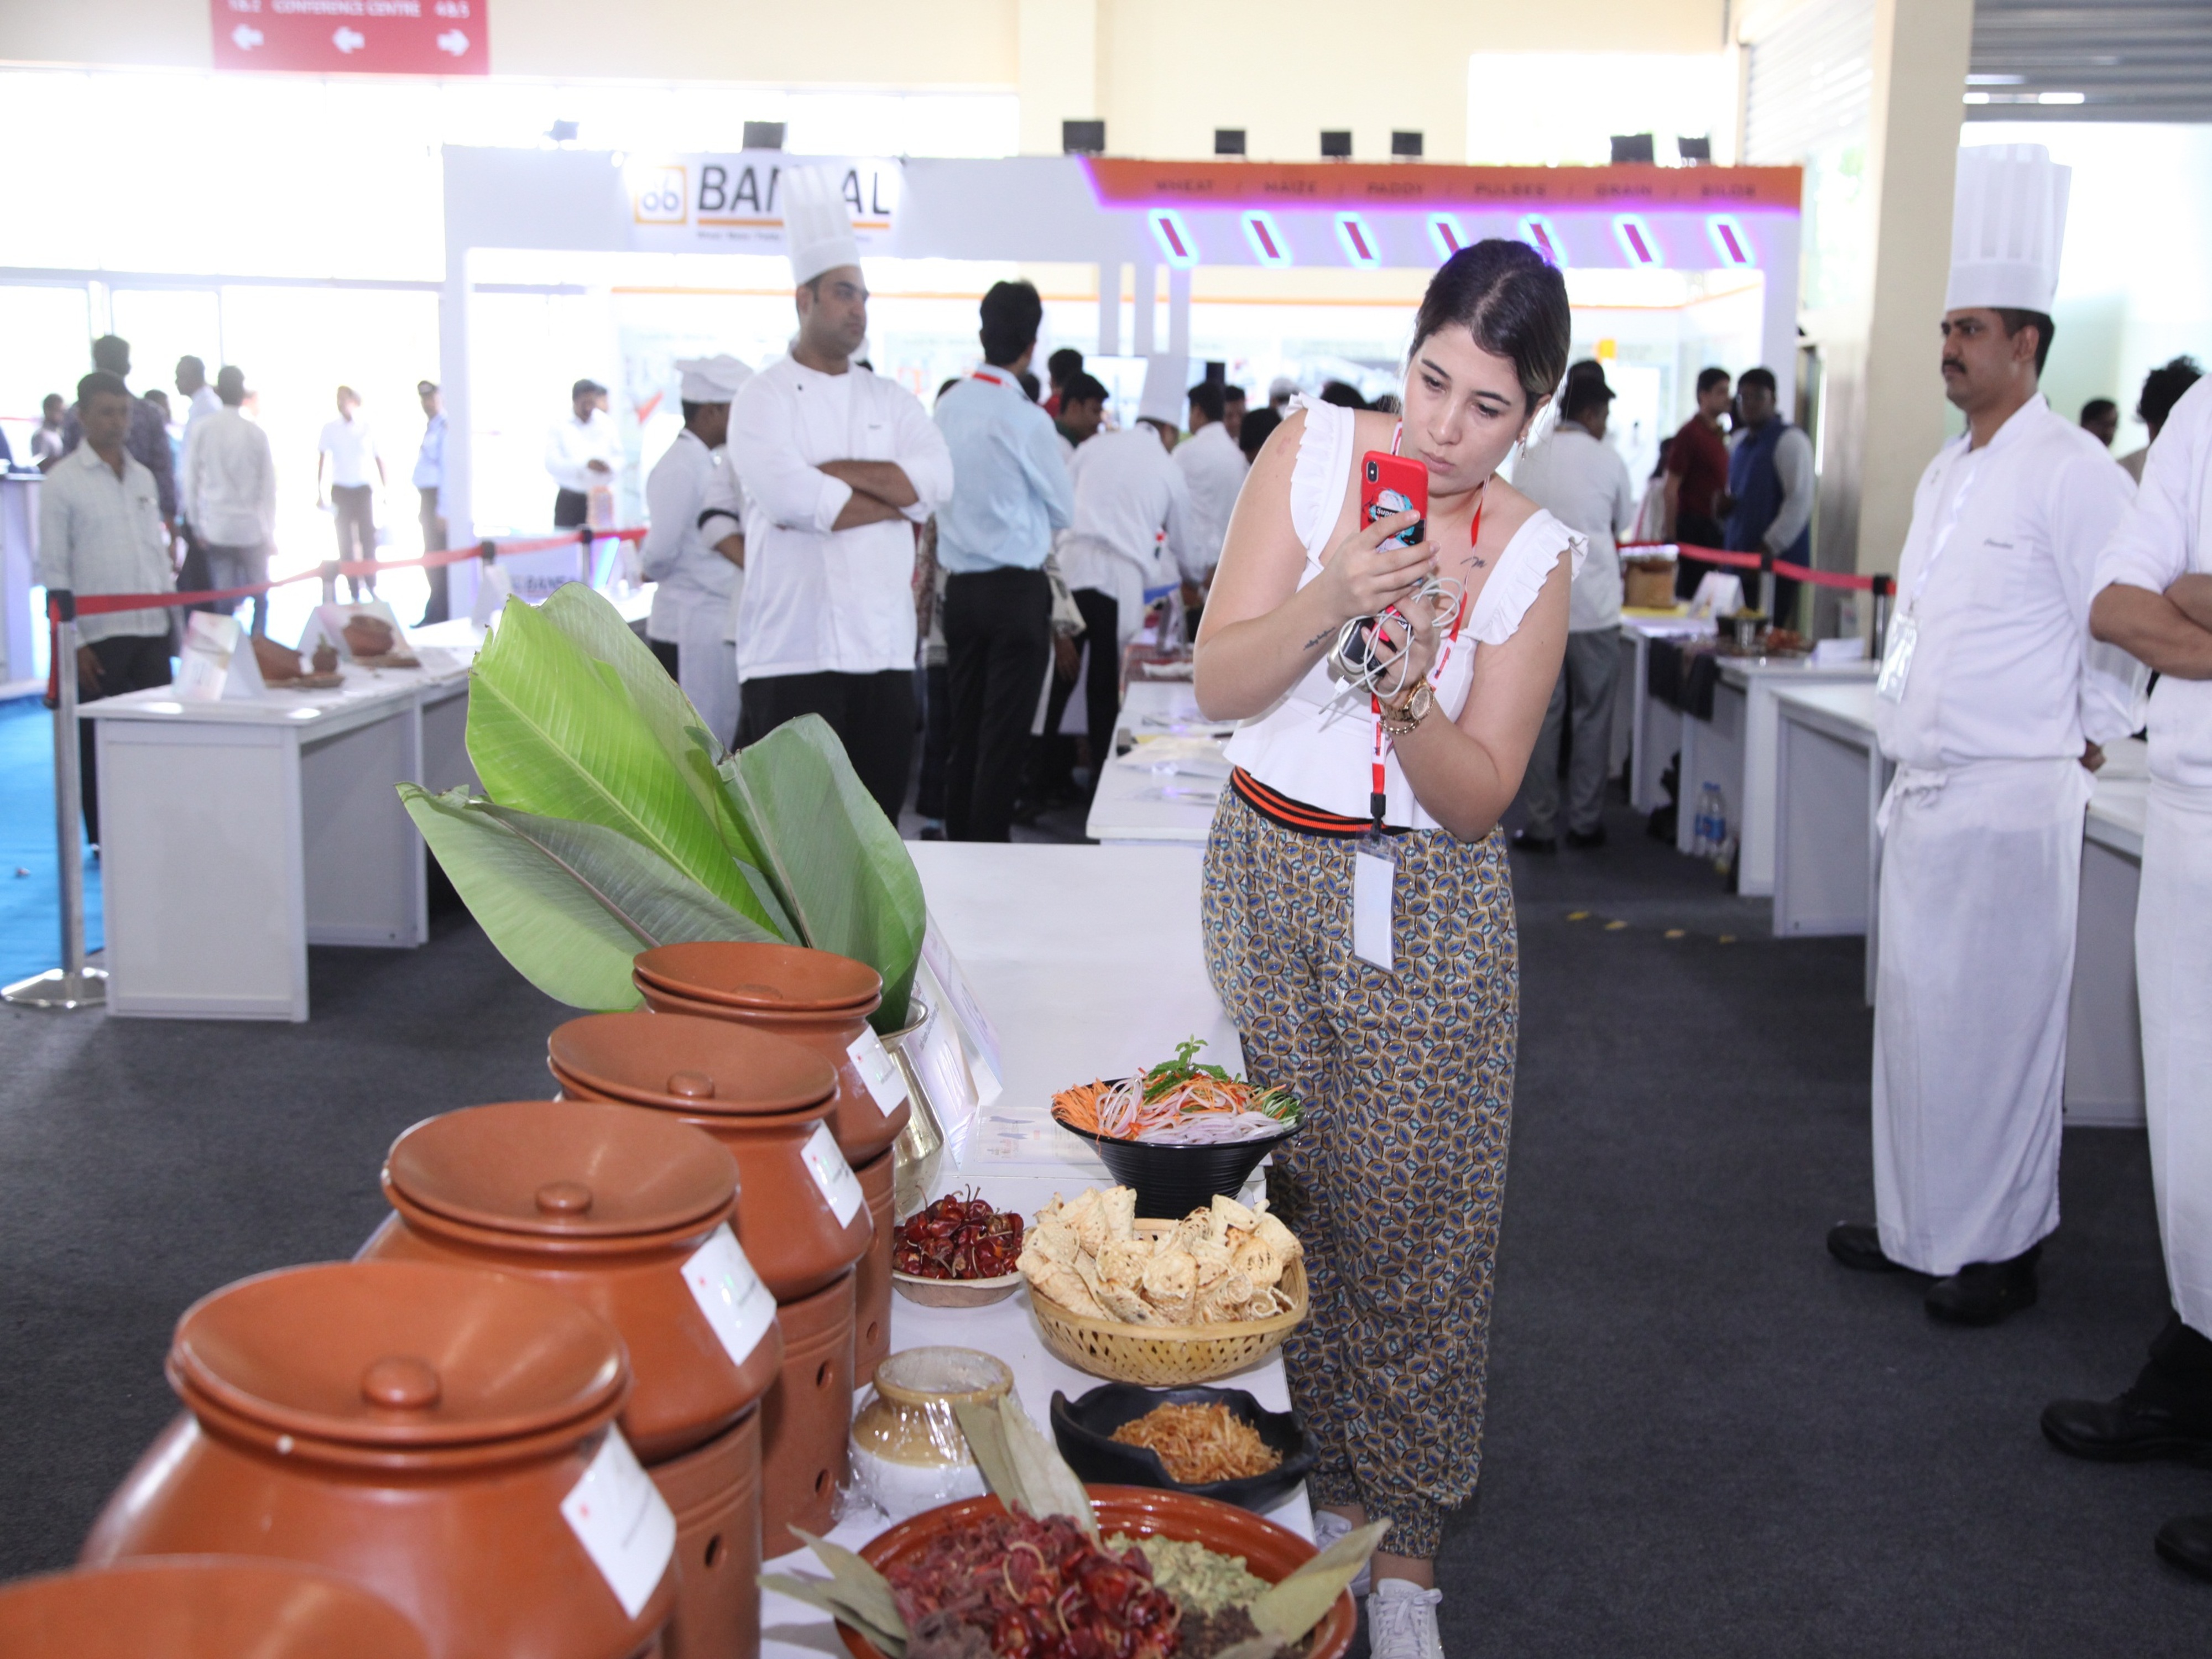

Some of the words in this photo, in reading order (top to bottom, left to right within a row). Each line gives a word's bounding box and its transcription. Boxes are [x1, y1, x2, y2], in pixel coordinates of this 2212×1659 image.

[273, 0, 366, 15] CONFERENCE
[367, 1, 421, 17] CENTRE
[1155, 179, 1213, 192] WHEAT
[1264, 180, 1316, 194] MAIZE
[1367, 181, 1423, 194] PADDY
[1474, 183, 1546, 196] PULSES
